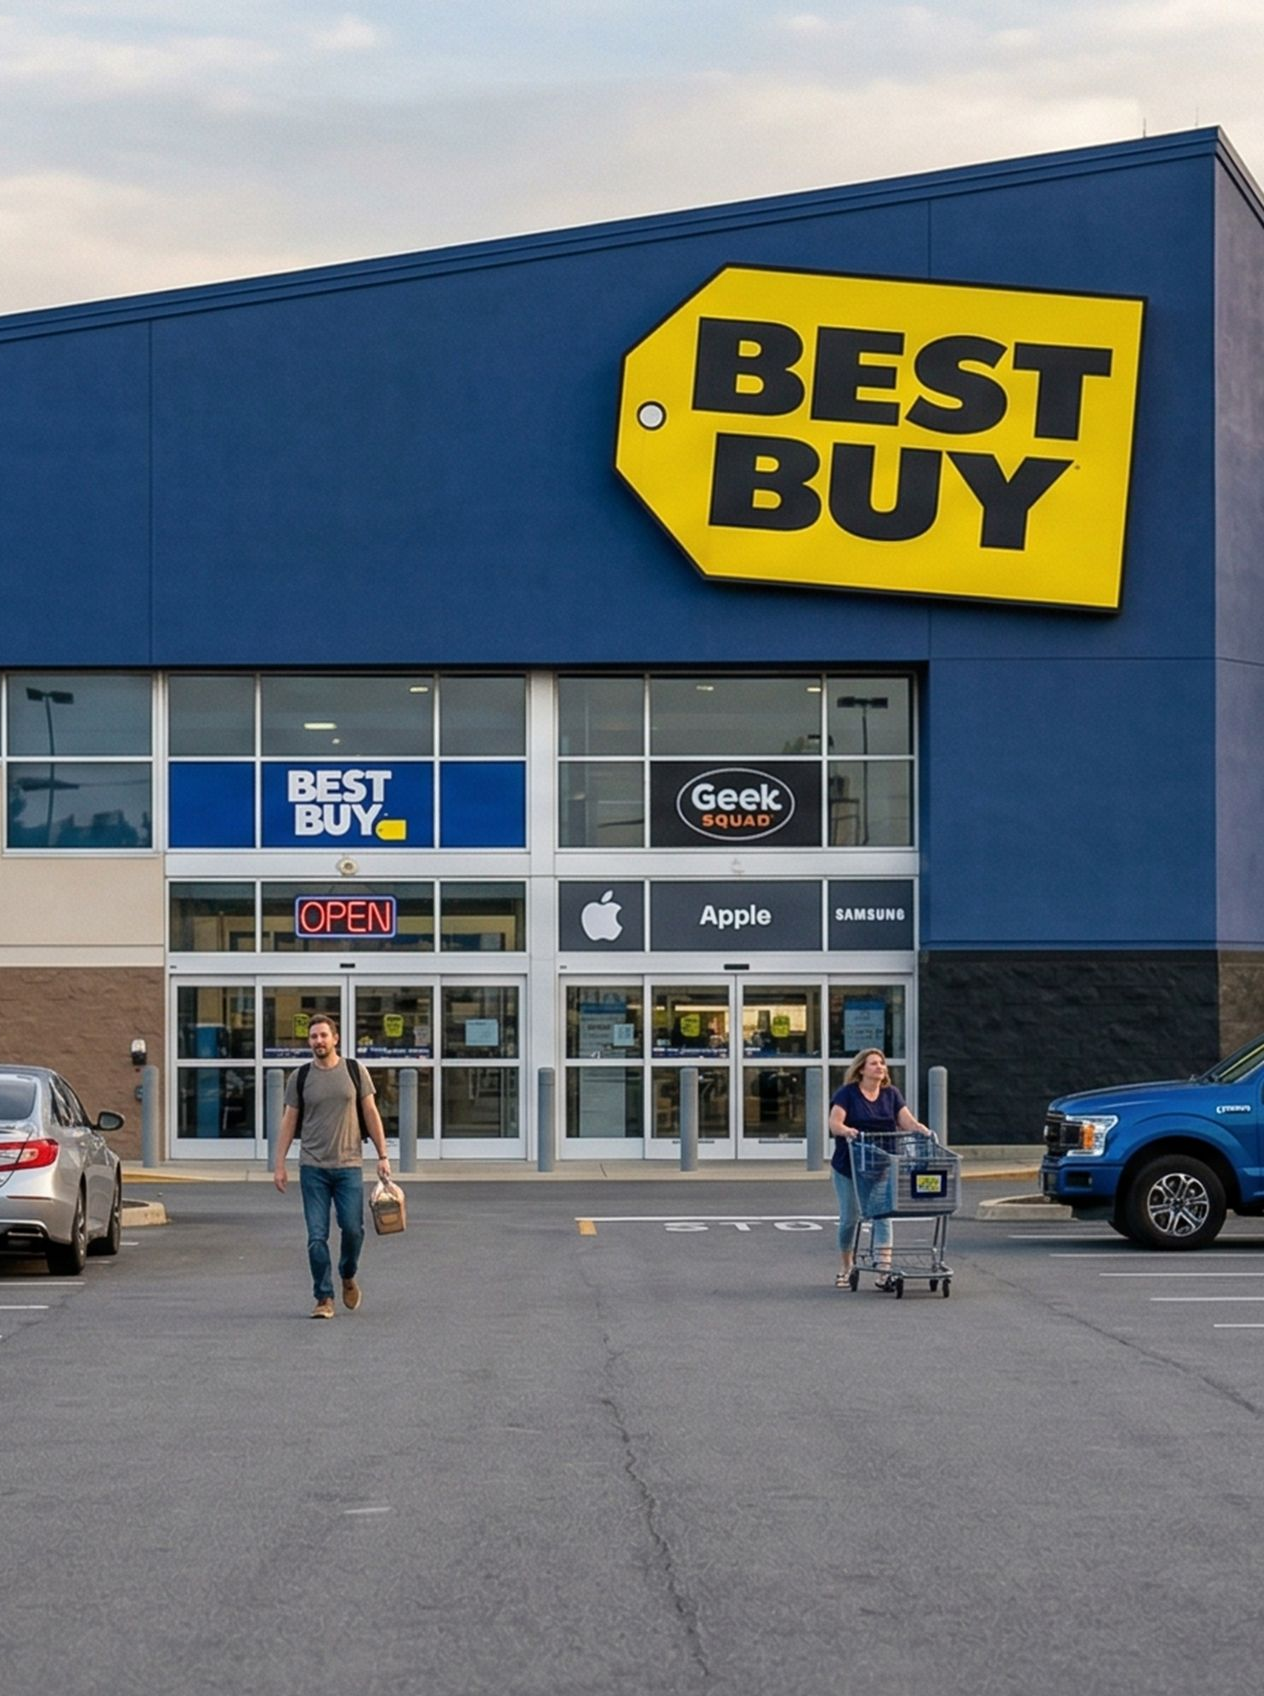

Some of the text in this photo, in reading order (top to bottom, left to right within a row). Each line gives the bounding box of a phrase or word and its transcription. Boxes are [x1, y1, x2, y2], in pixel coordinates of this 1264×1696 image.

[691, 316, 1114, 441] BEST
[708, 432, 1075, 551] BUY
[287, 769, 392, 802] BEST
[691, 782, 783, 811] Geek
[294, 803, 383, 836] BUY
[702, 813, 771, 829] SQUAD
[300, 901, 391, 933] OPEN
[699, 904, 772, 930] Apple
[835, 907, 906, 921] SAMSUNG
[664, 1221, 872, 1232] STO
